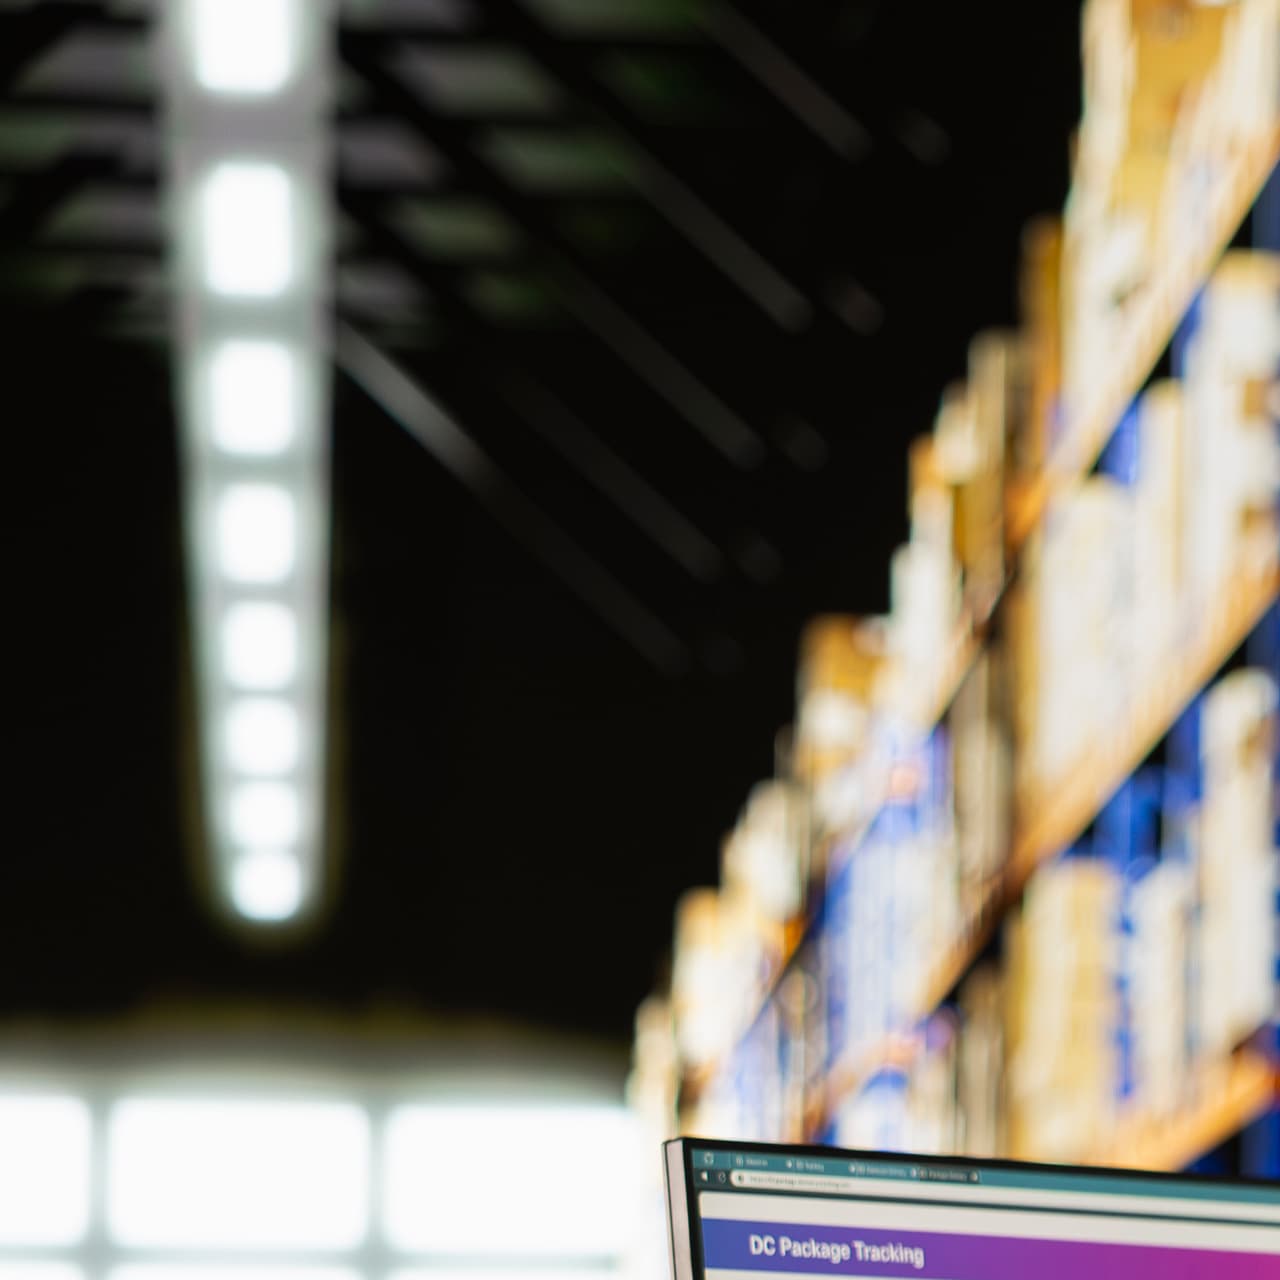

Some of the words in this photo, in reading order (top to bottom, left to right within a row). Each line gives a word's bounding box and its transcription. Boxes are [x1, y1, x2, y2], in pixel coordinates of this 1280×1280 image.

[750, 1234, 776, 1256] DC
[779, 1236, 850, 1264] Package
[853, 1241, 925, 1268] Tracking
